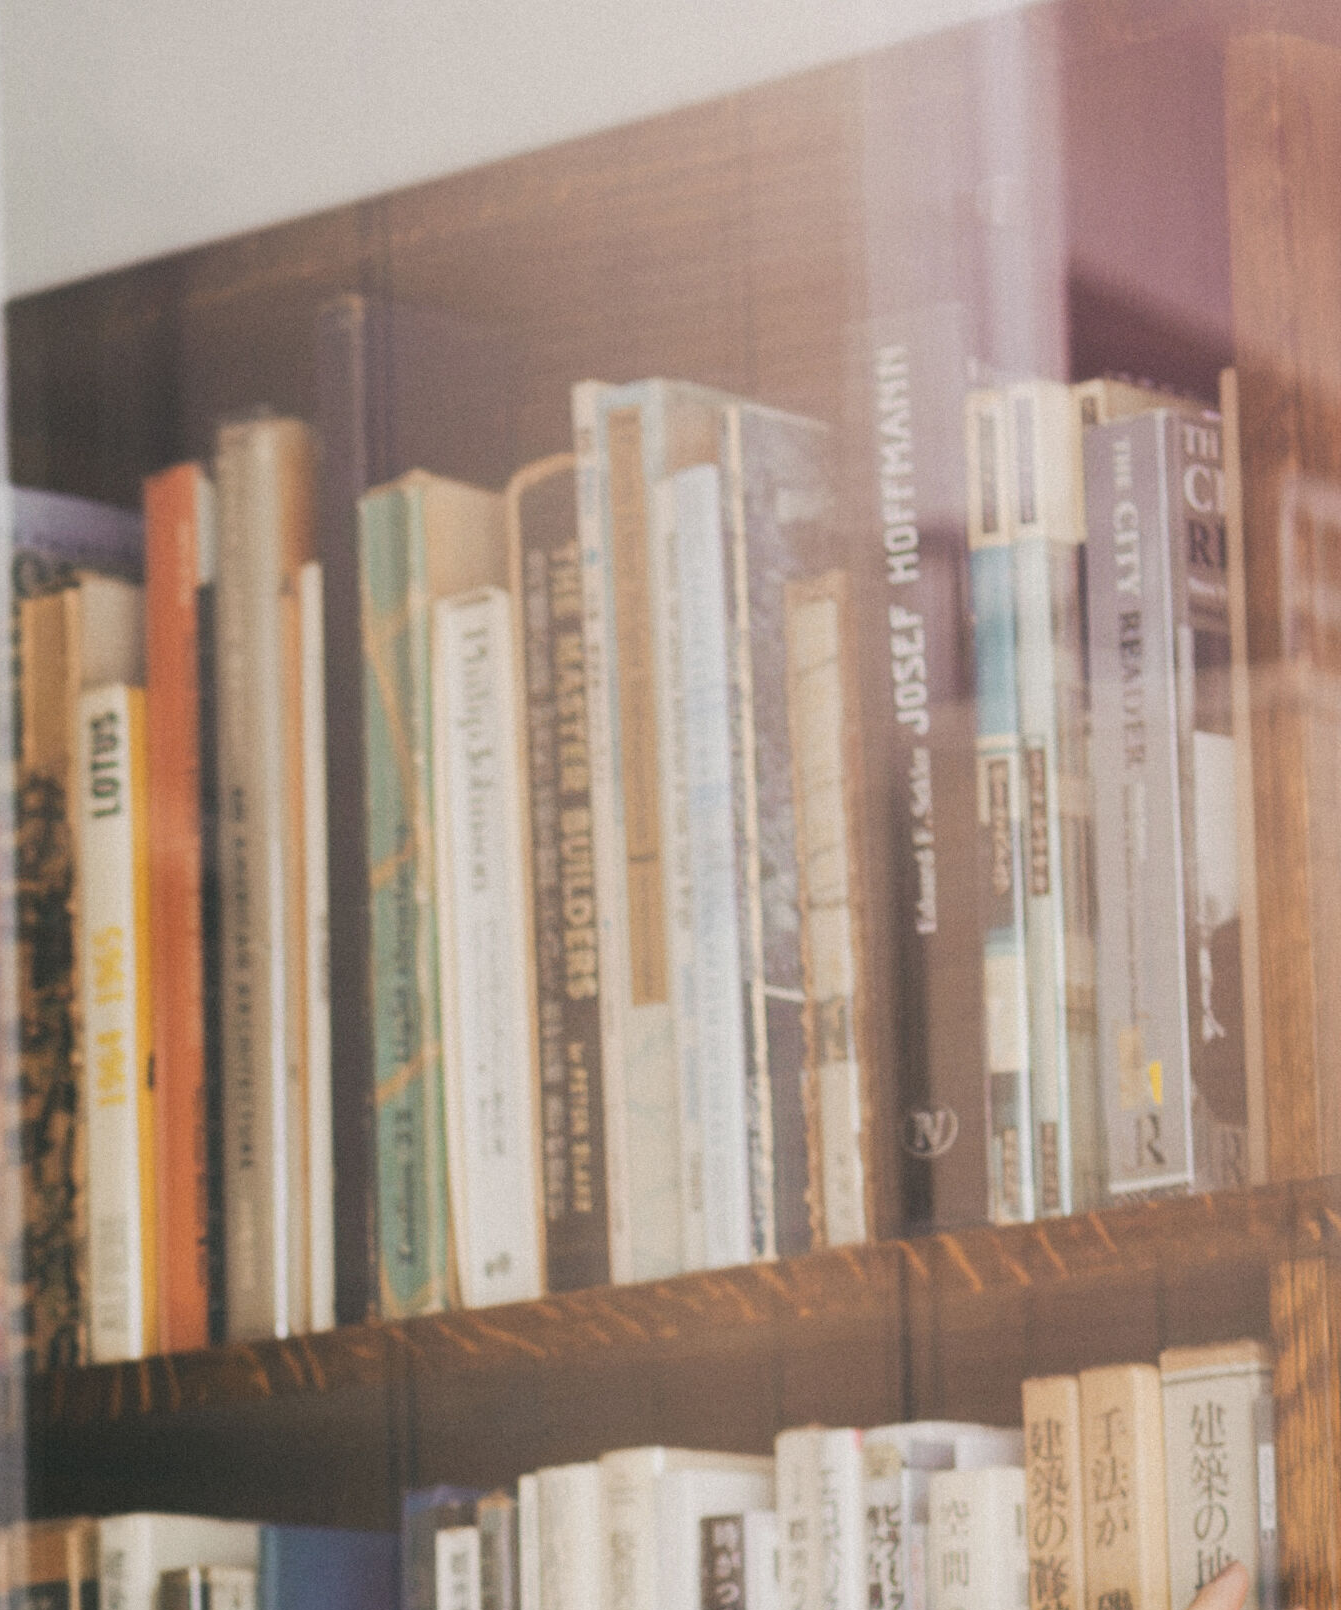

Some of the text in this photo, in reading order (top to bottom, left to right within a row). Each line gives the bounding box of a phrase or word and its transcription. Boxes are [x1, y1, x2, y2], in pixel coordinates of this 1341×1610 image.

[874, 343, 928, 737] JOSEF HOFFMANN
[1113, 501, 1142, 597] CITY
[91, 708, 119, 820] LOTUS
[550, 629, 586, 792] MASTER
[1118, 610, 1150, 770] READER
[559, 806, 595, 1000] BUILDERS
